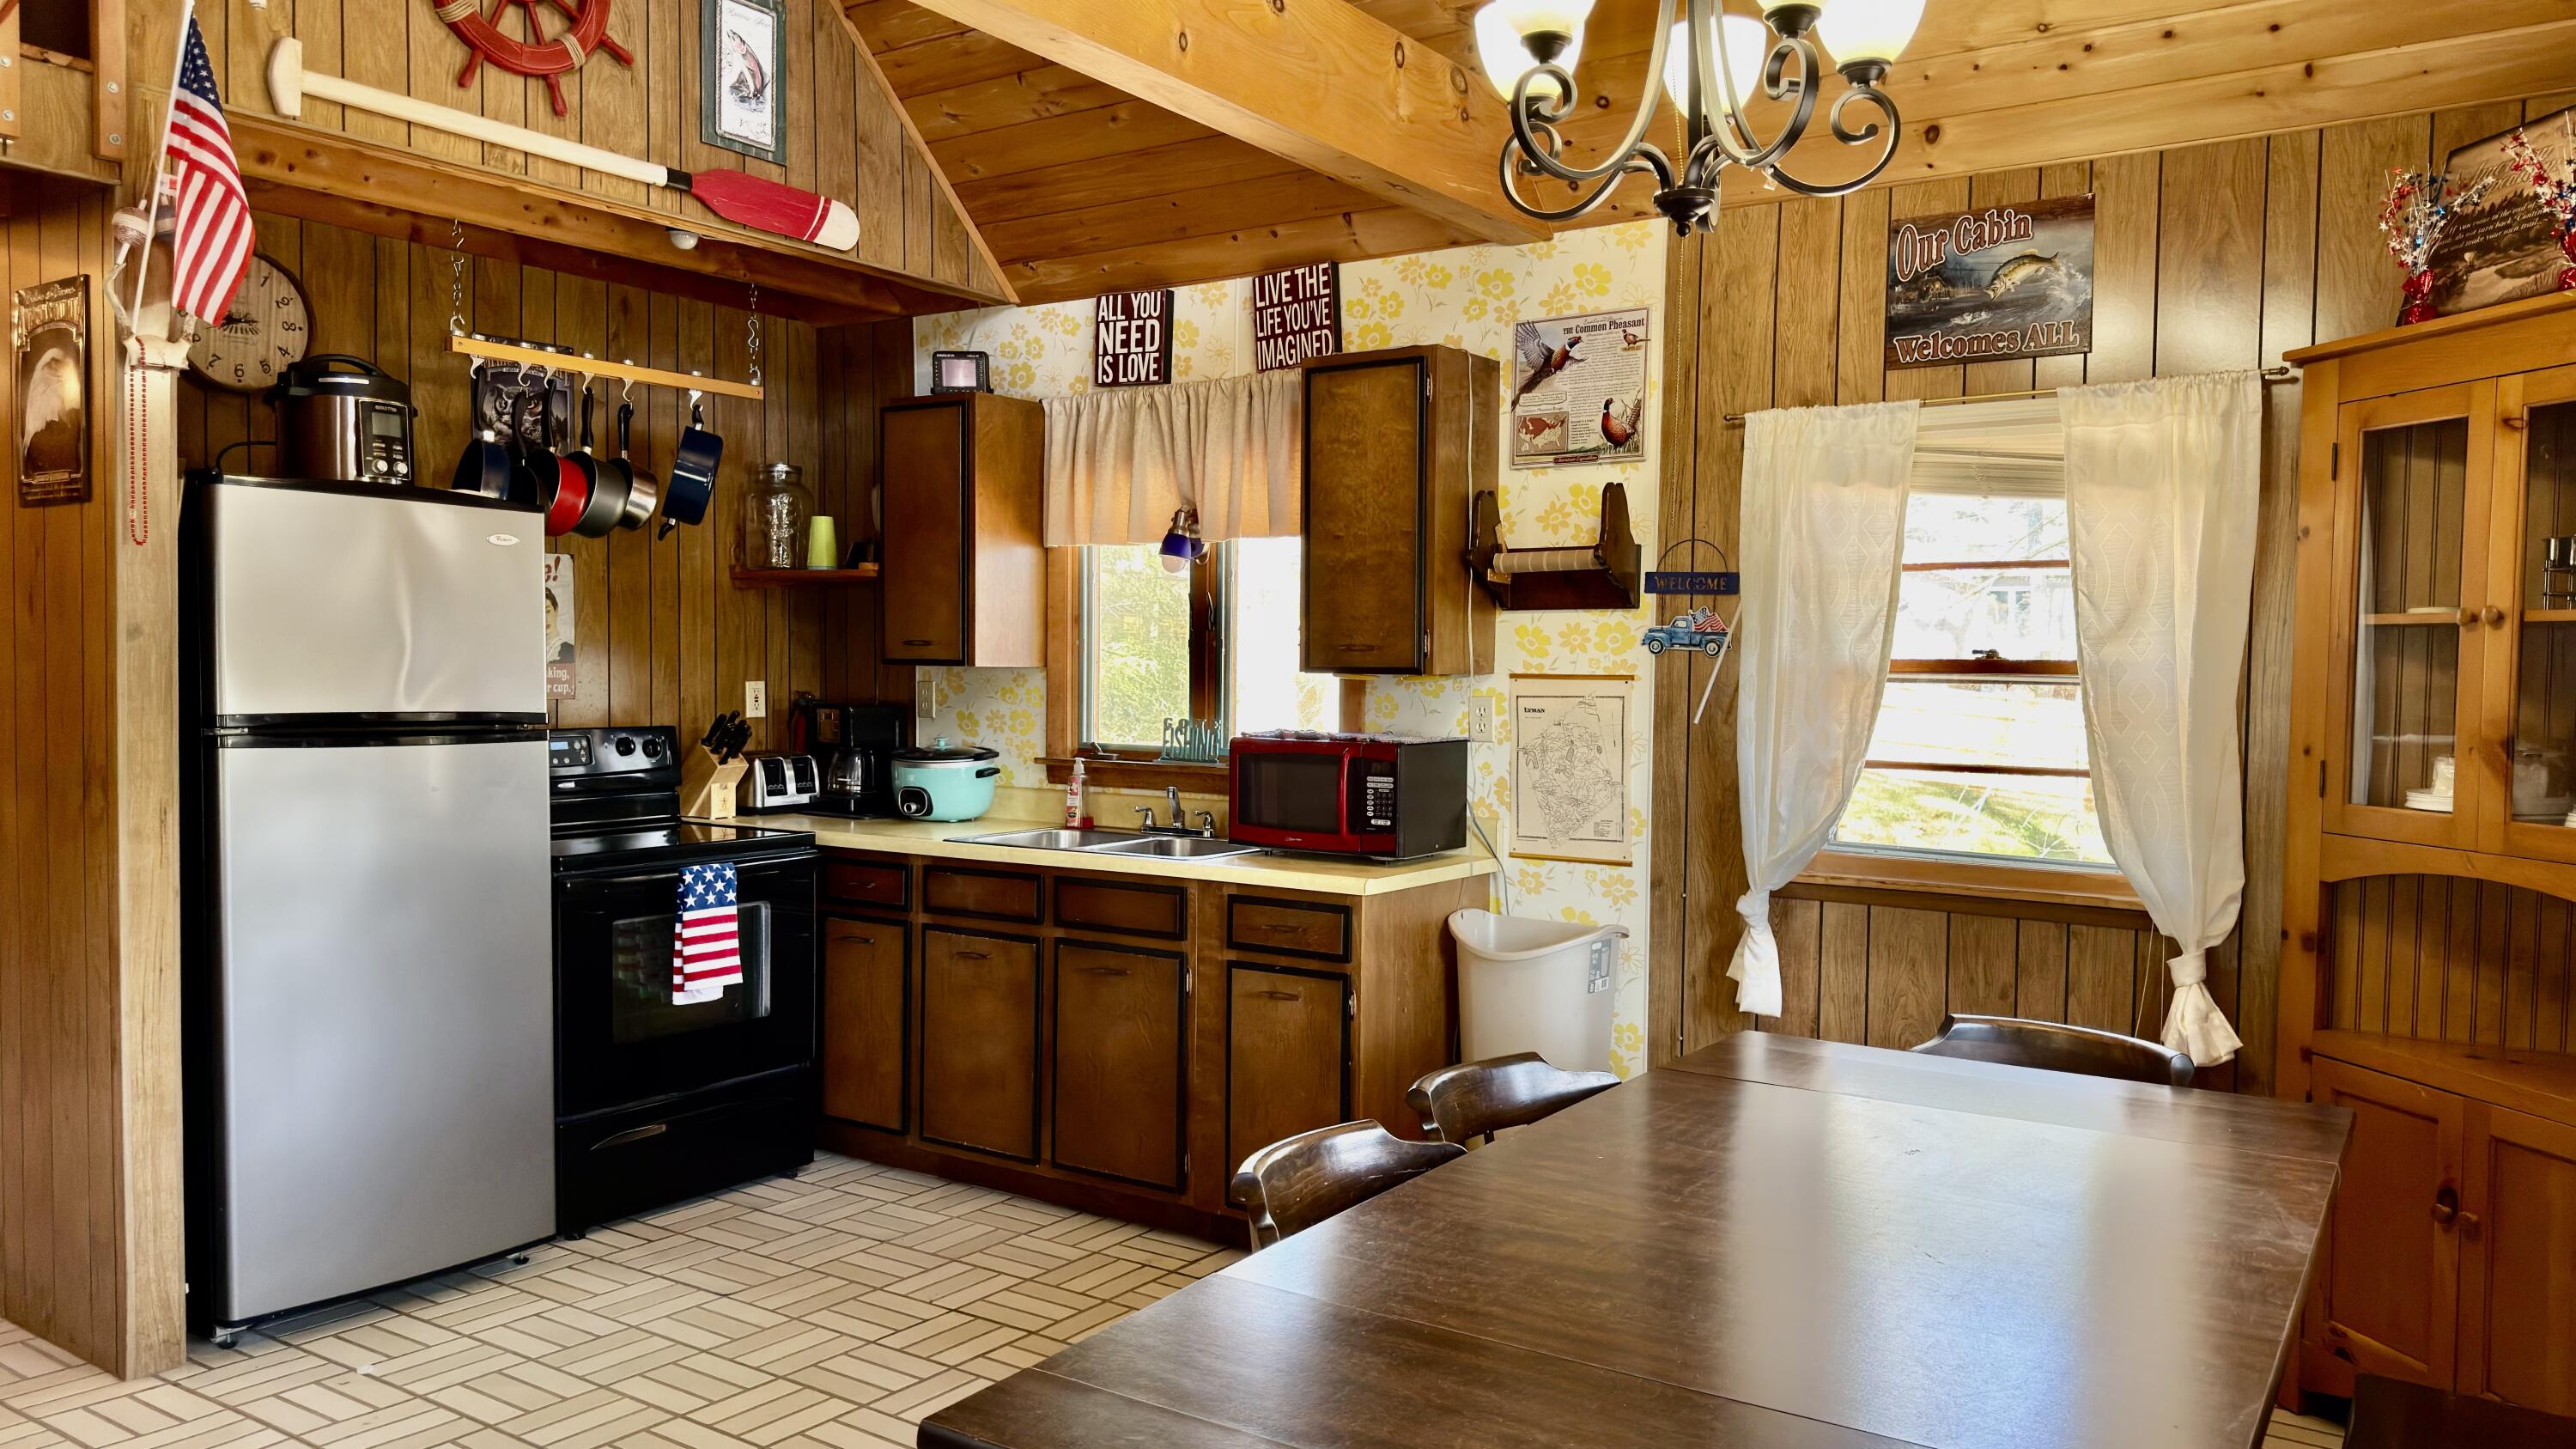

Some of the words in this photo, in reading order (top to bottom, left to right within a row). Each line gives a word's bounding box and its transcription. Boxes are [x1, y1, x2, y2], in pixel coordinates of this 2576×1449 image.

[2512, 205, 2527, 214] end
[1896, 224, 1949, 282] Our
[1953, 210, 2033, 255] Cabin
[261, 276, 270, 287] 1
[1255, 271, 1292, 307] LIVE
[1294, 263, 1330, 299] THE
[275, 296, 290, 309] 2
[1097, 295, 1126, 322] ALL
[1130, 291, 1161, 319] YOU
[1256, 307, 1282, 338] LIFE
[1283, 297, 1330, 331] YOU'VE
[282, 321, 296, 332] 3
[1575, 322, 1607, 334] Common
[1608, 318, 1644, 330] Pheasant
[1098, 320, 1160, 355] NEED
[1894, 331, 2020, 362] Welcomes
[2022, 320, 2080, 351] ALL
[276, 345, 291, 357] 4
[1257, 329, 1333, 371] IMAGINED
[208, 354, 222, 368] 7
[259, 359, 271, 374] 5
[1097, 355, 1114, 383] IS
[1118, 352, 1159, 383] LOVE
[234, 363, 245, 378] 6
[1655, 575, 1727, 591] WELCOME
[1162, 718, 1221, 761] FISHING
